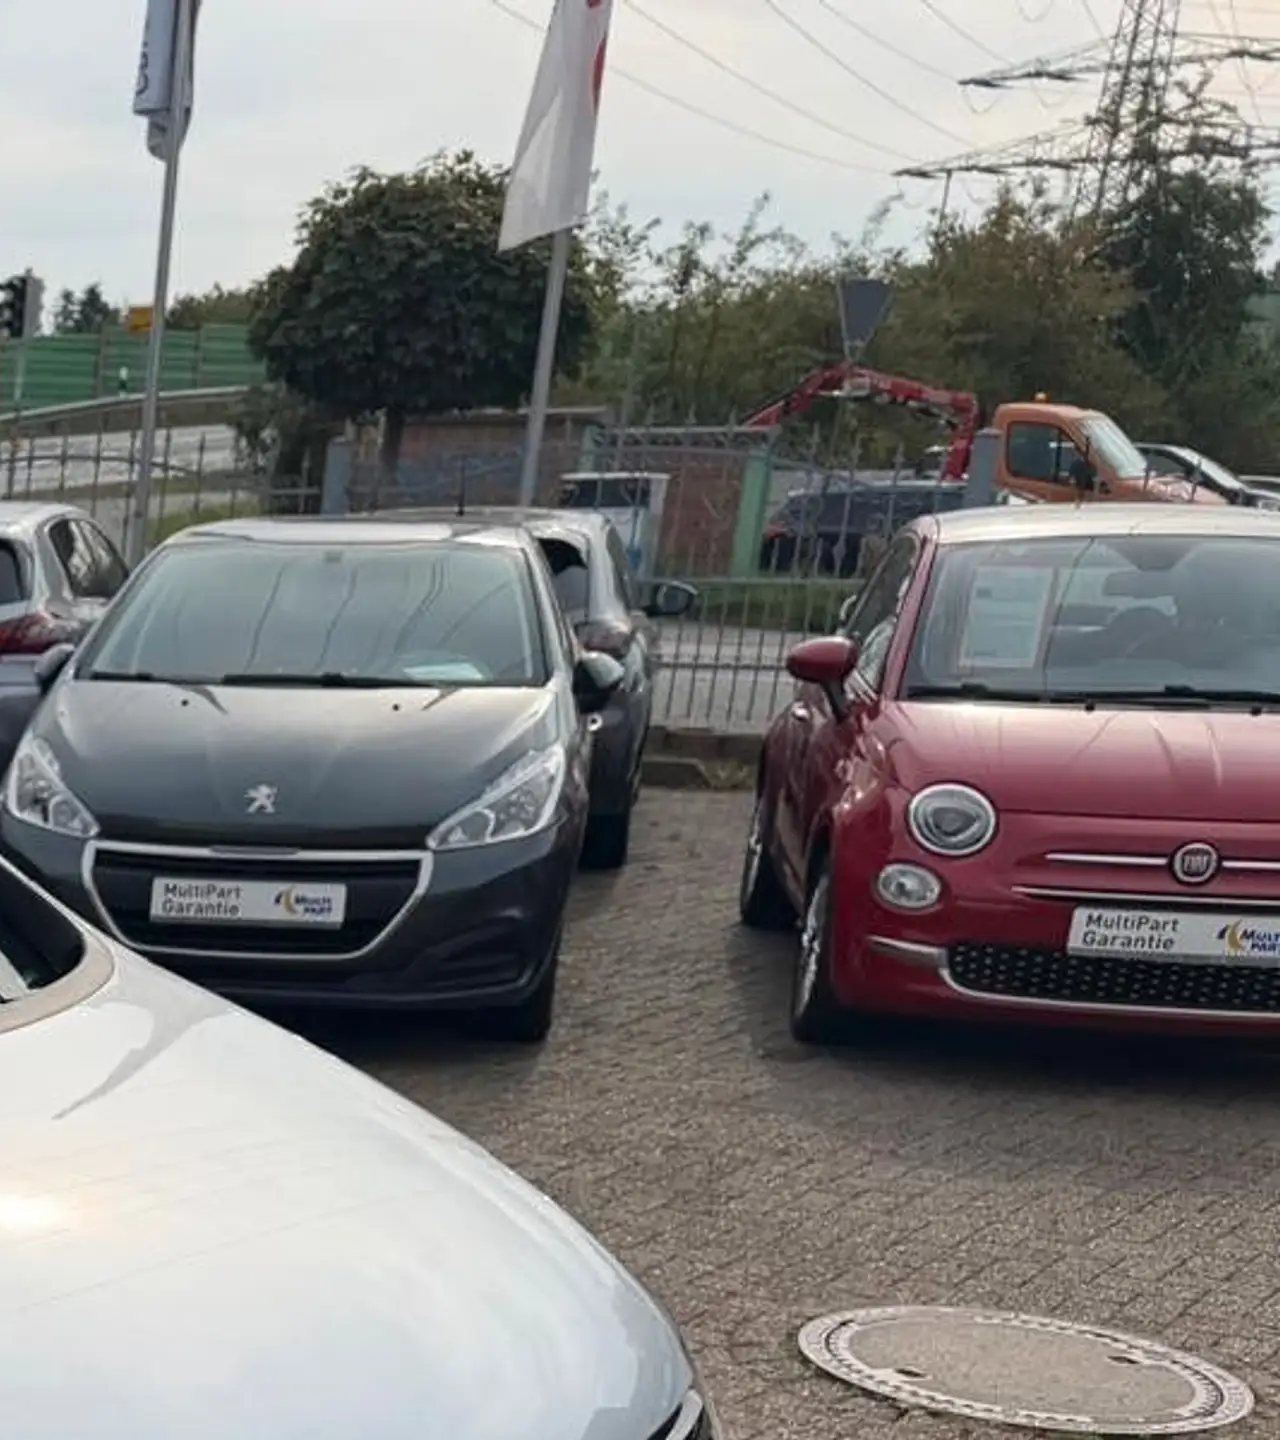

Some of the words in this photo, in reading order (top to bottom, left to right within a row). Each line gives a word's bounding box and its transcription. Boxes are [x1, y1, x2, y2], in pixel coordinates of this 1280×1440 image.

[164, 883, 242, 899] MultiPart
[161, 899, 241, 917] Garantie
[1085, 913, 1180, 933] MultiPart
[1082, 931, 1176, 950] Garantie
